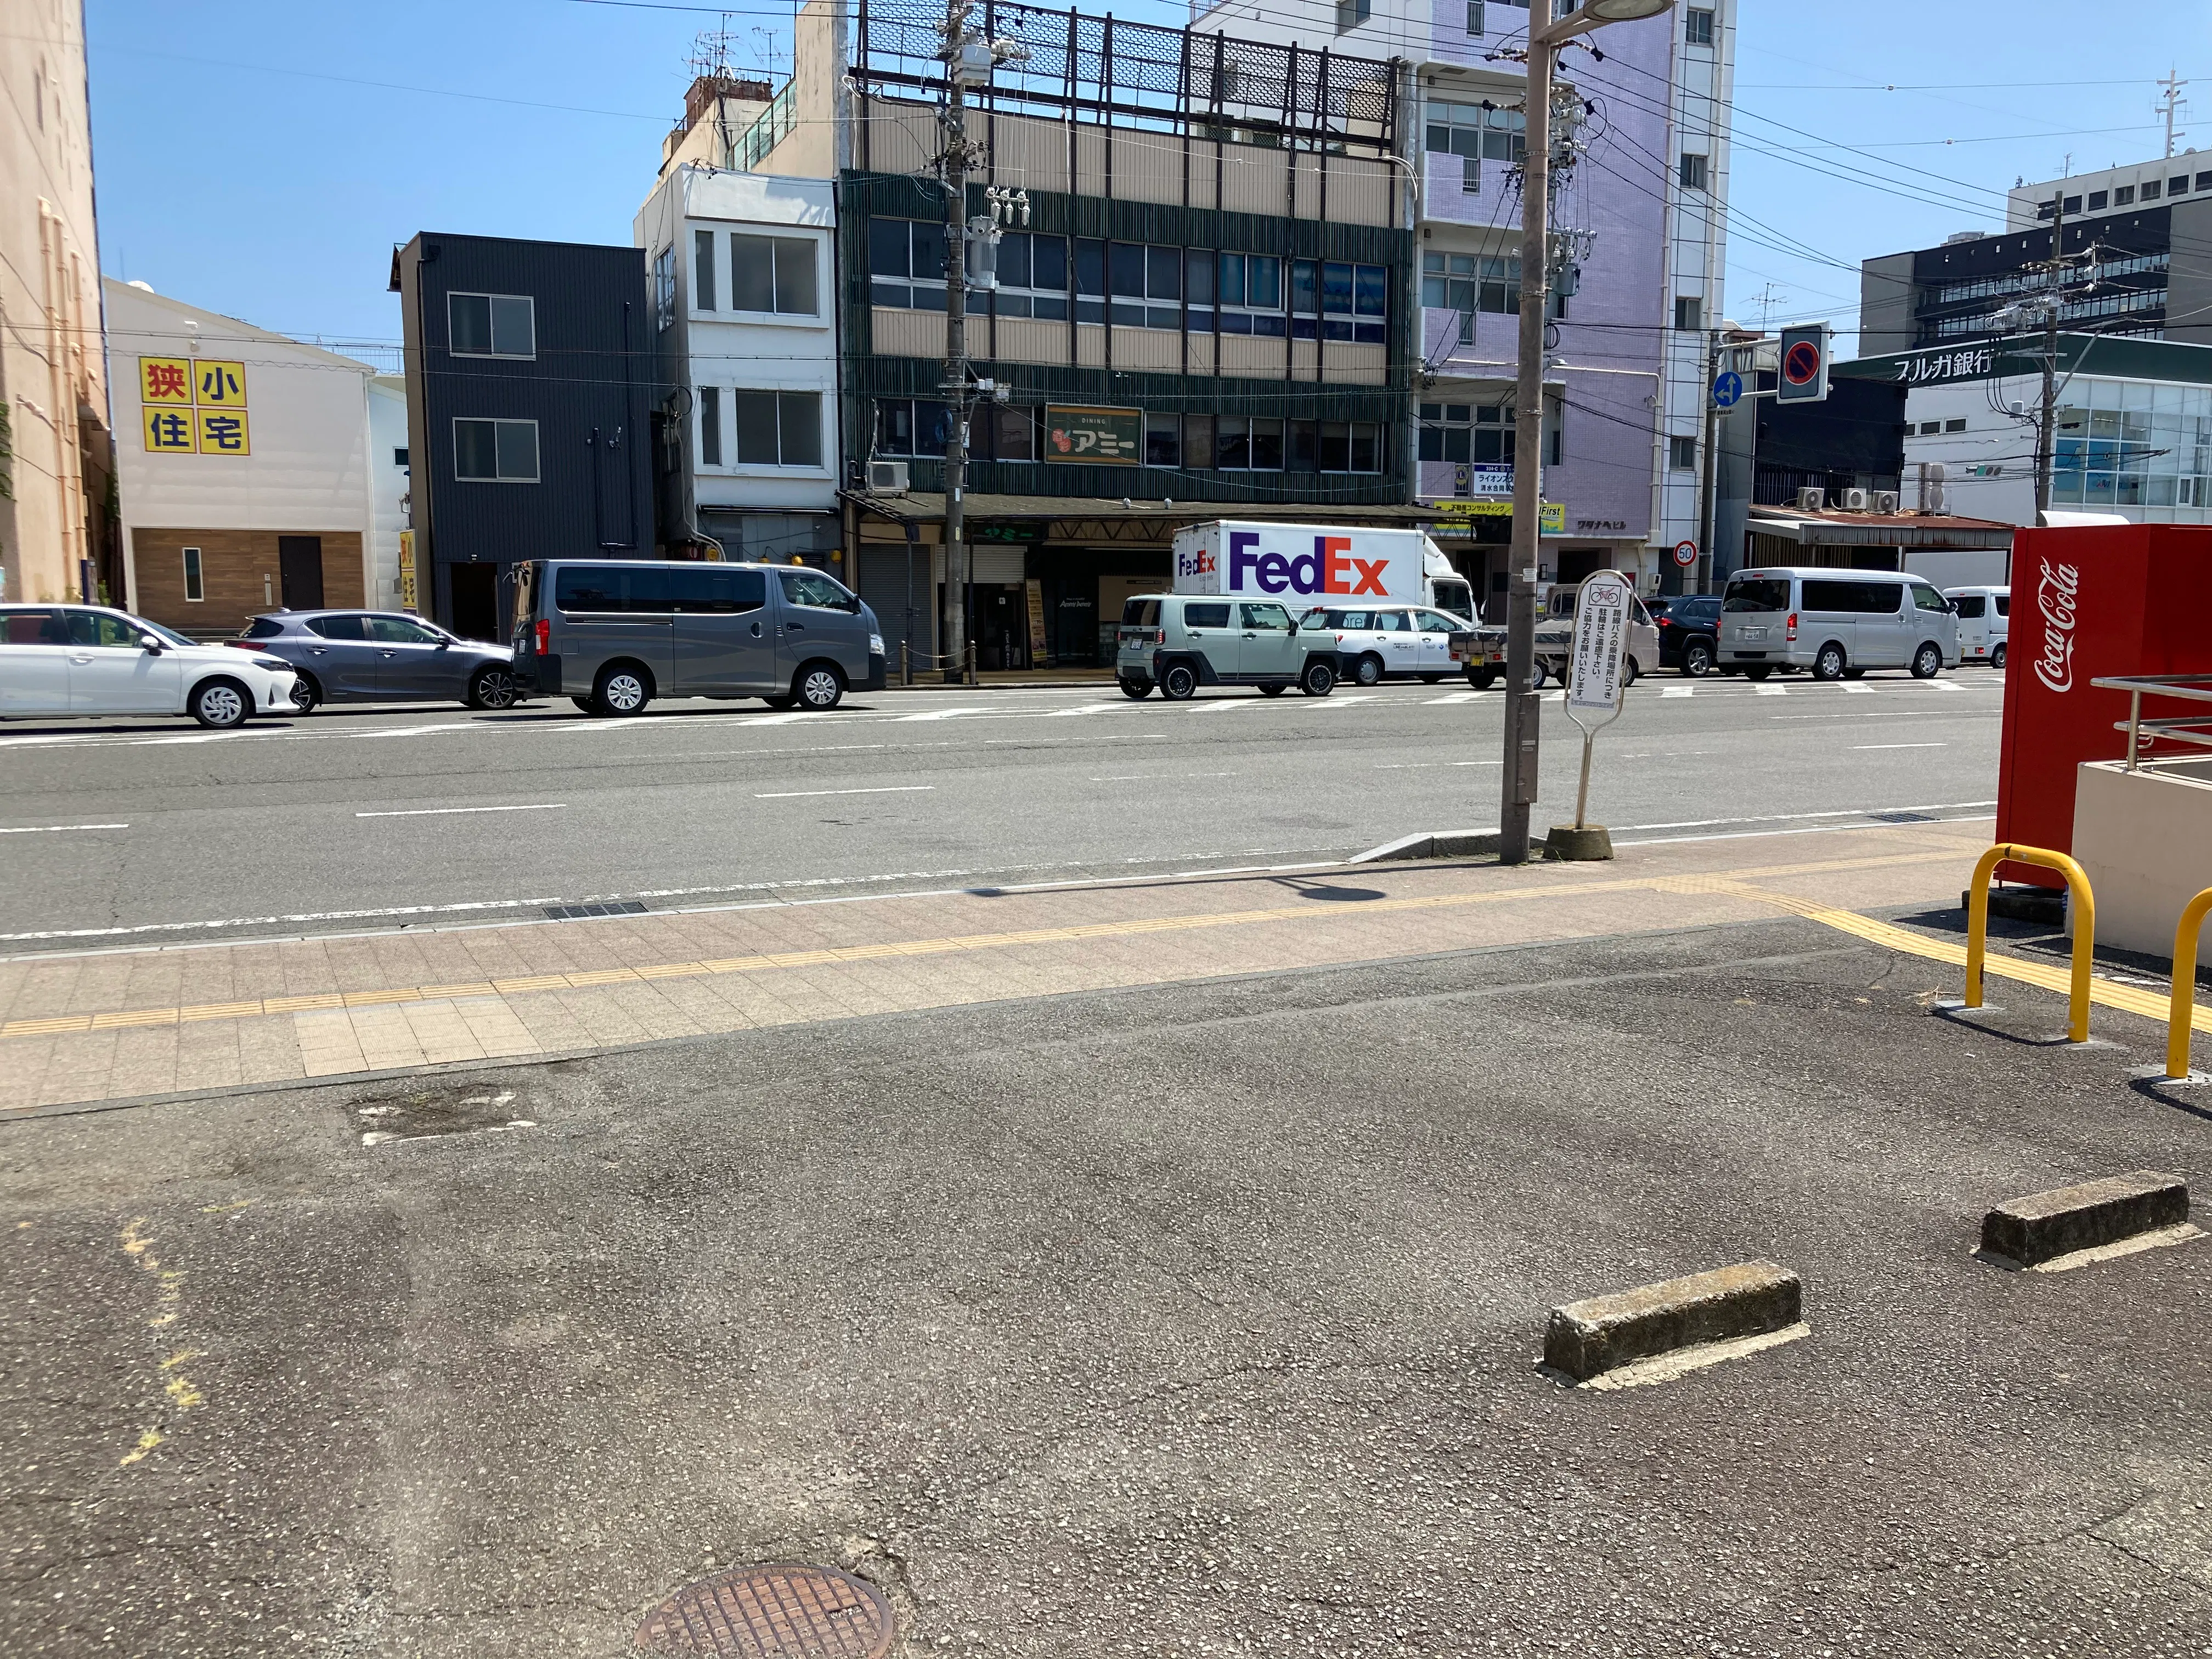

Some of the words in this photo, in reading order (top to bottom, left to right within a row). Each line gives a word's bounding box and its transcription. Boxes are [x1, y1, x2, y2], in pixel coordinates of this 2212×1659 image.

[1895, 348, 1995, 382] スルガ銀行
[1072, 430, 1135, 455] アミー
[1577, 521, 1627, 530] ワタナベビル
[1179, 550, 1216, 577] FedEx
[1229, 531, 1390, 596] FedEx
[1679, 548, 1691, 559] 50
[1592, 608, 1607, 679] 駐輪はご遠慮下さい。
[2034, 555, 2078, 692] Coca-Cola
[1576, 607, 1593, 700] ご協力をお願いいたします。
[1604, 609, 1622, 699] 路線バスの乗降場所につき
